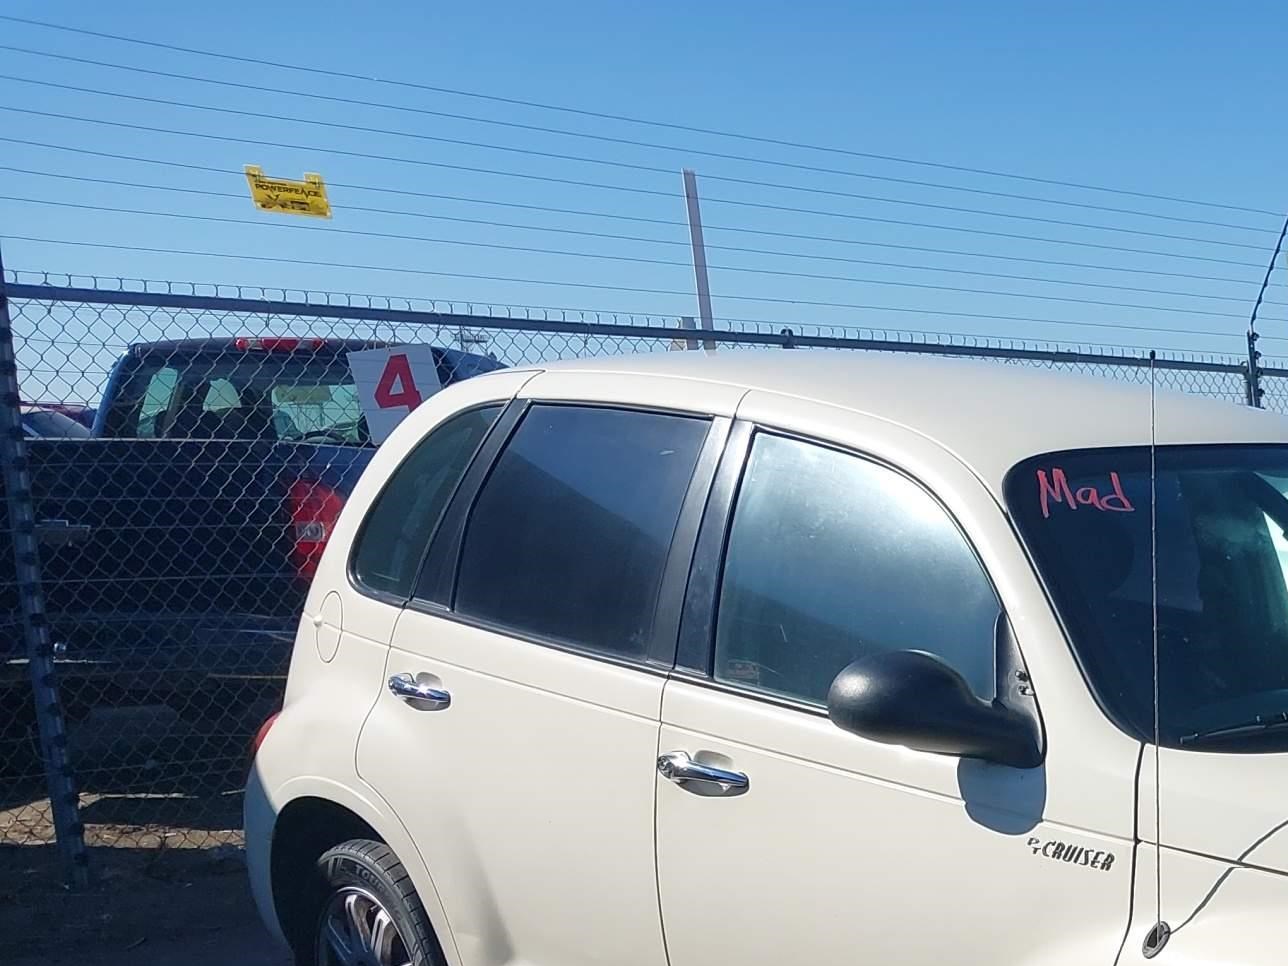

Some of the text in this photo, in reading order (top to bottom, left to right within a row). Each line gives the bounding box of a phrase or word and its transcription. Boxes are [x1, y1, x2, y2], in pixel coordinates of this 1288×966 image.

[374, 353, 423, 413] 4
[1036, 467, 1136, 519] Mad
[1041, 841, 1115, 871] CRUISER
